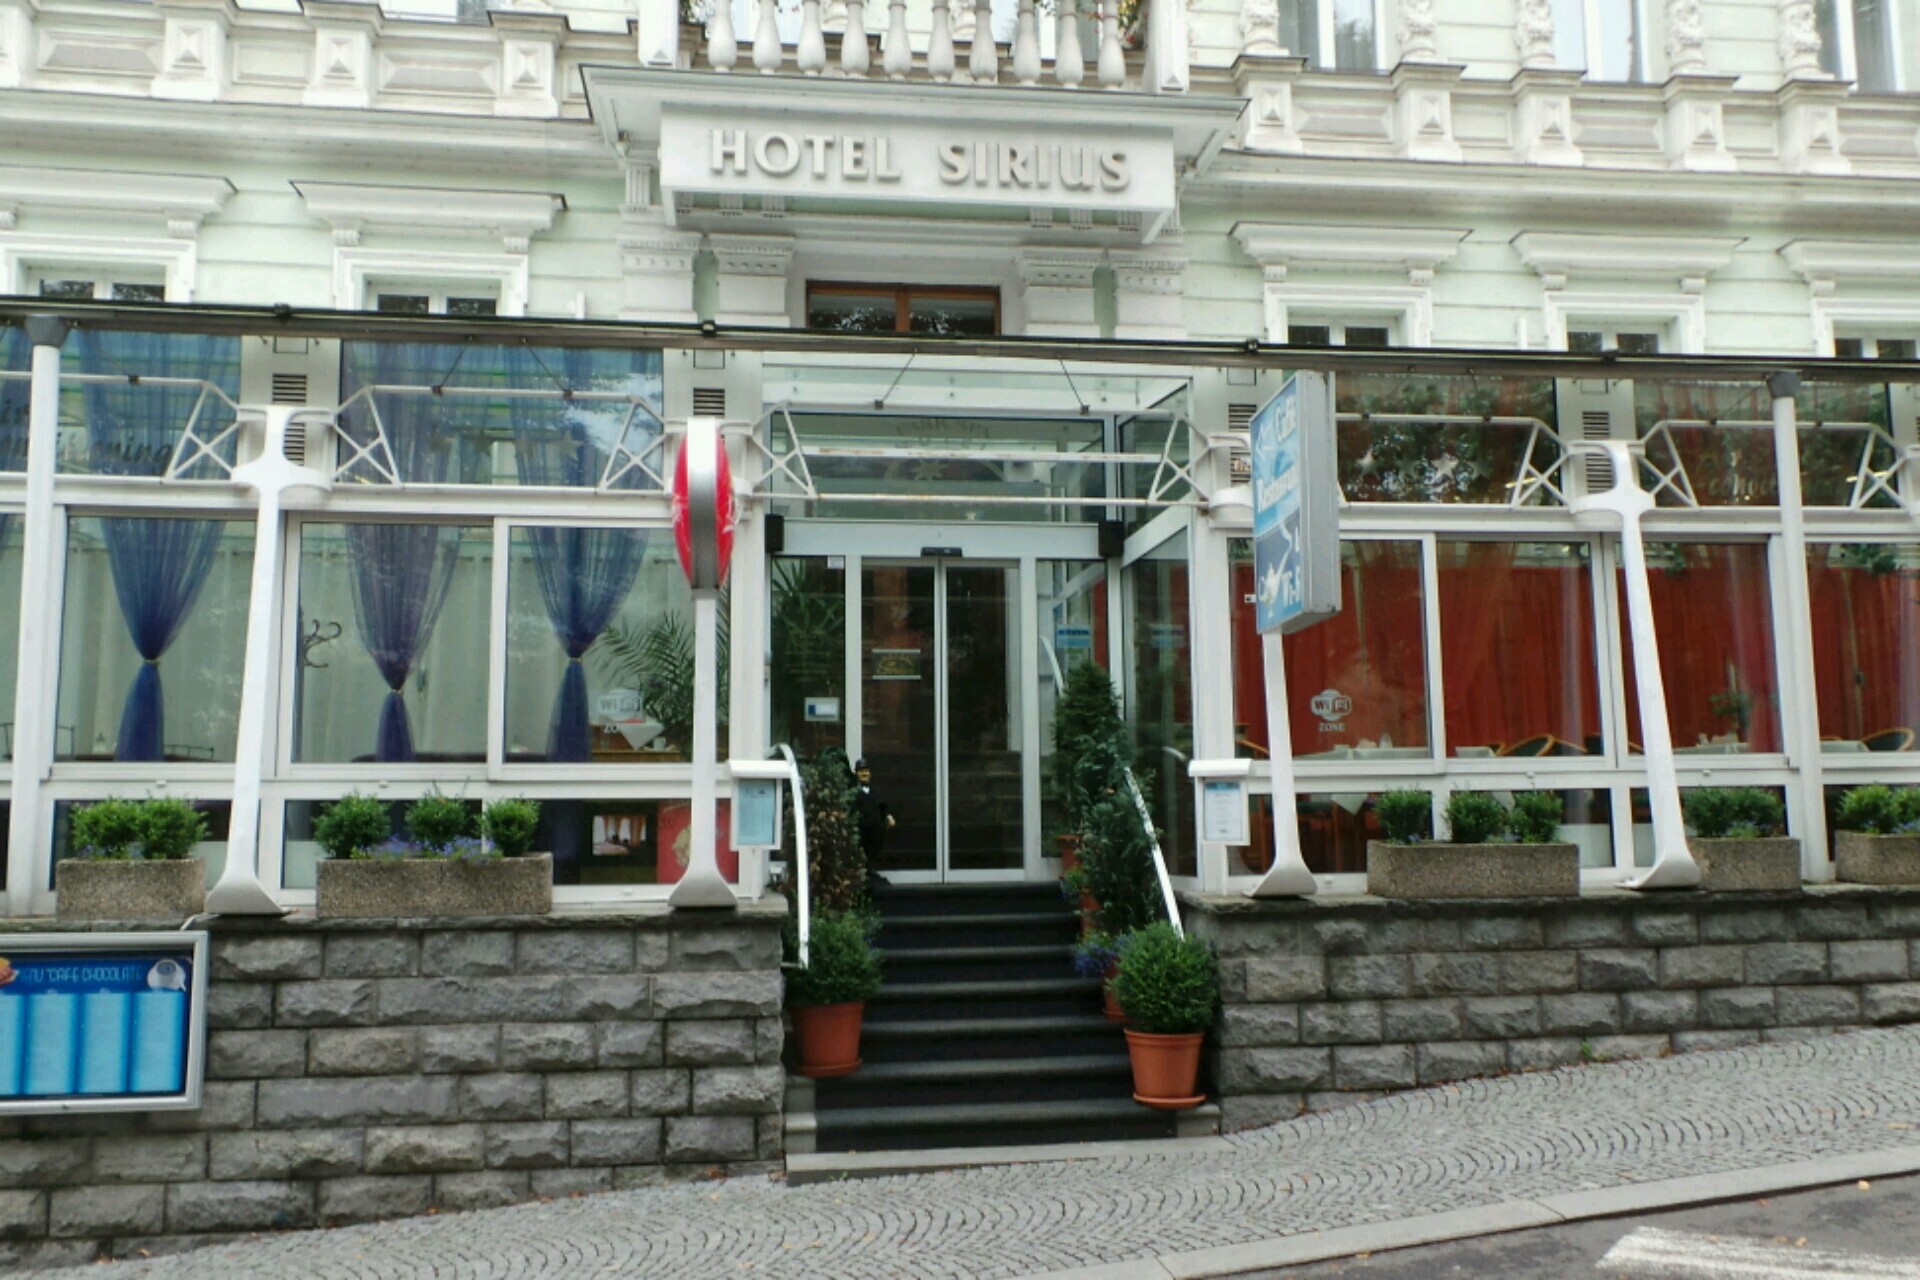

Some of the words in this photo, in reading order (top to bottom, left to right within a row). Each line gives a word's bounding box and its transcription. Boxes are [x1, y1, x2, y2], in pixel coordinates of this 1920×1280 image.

[710, 129, 901, 183] HOTEL
[939, 140, 1131, 192] SIRIUS
[1319, 723, 1345, 732] ZONE
